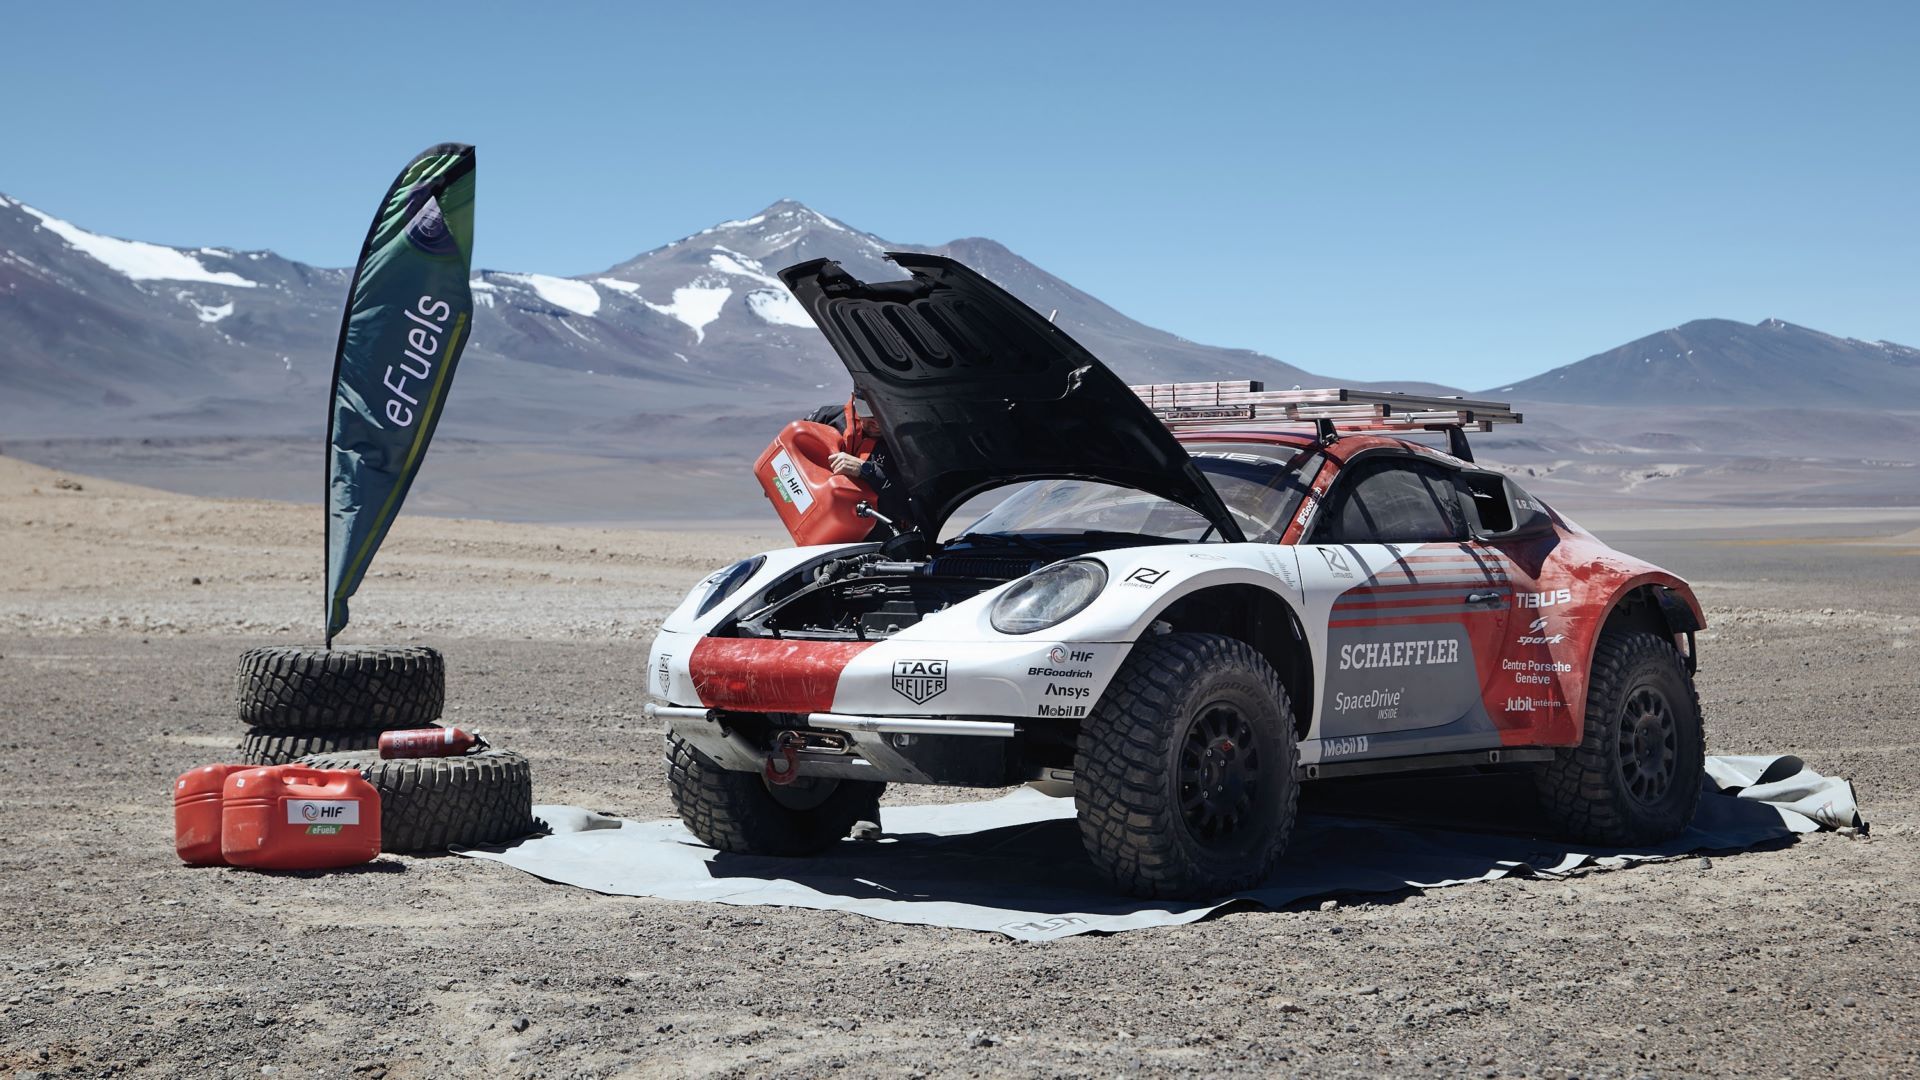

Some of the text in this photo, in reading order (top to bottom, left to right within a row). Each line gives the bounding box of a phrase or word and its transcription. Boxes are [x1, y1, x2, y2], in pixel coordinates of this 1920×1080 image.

[383, 295, 450, 427] eFuels
[787, 477, 803, 496] HIF
[1516, 589, 1571, 609] TIBUS
[1517, 633, 1565, 646] spark
[1070, 650, 1095, 663] HIF
[1339, 639, 1459, 670] SCHAEFFLER
[898, 662, 942, 675] TAG
[1502, 659, 1571, 672] Centre Porsche
[1028, 667, 1093, 679] BFGoodrich
[1516, 672, 1551, 684] Genève
[895, 678, 943, 701] HEUER
[1045, 683, 1090, 699] Ansys
[1038, 704, 1072, 716] Mobil
[1377, 708, 1398, 719] INSIDE
[1324, 737, 1356, 757] Mobil
[320, 807, 343, 818] HIF
[312, 825, 336, 834] eFuels
